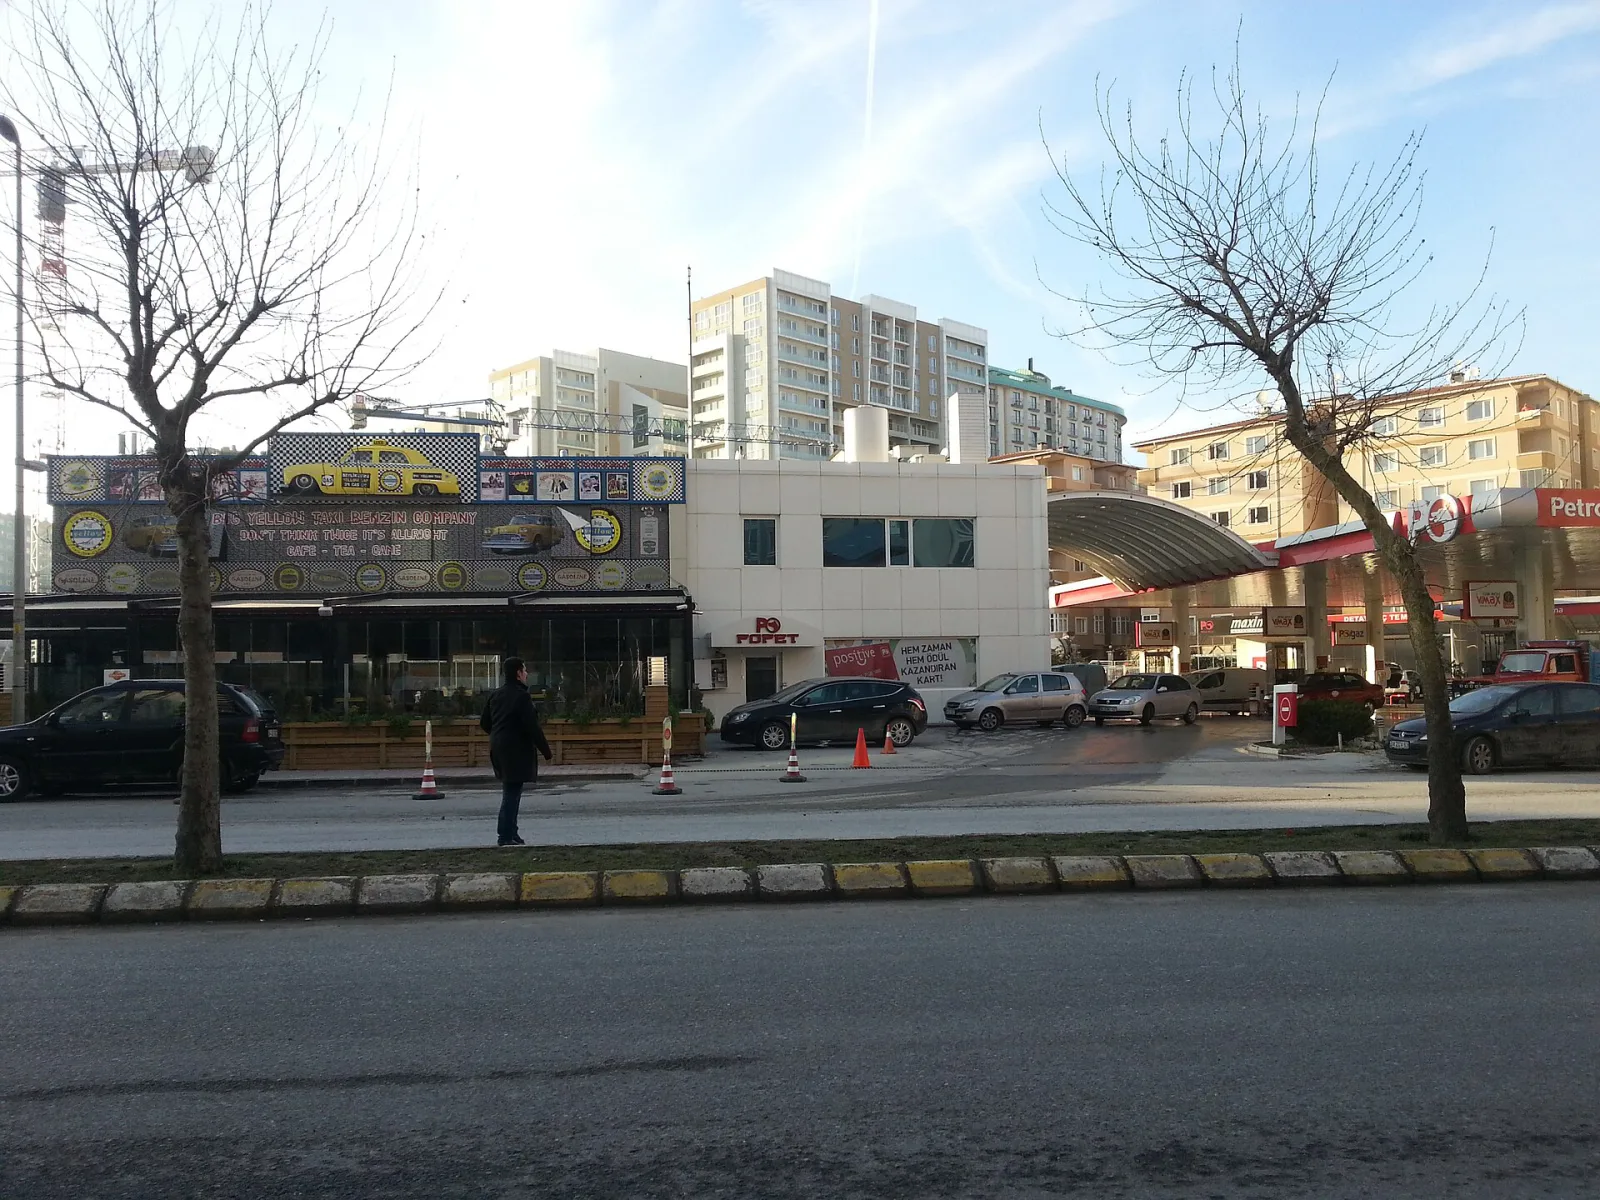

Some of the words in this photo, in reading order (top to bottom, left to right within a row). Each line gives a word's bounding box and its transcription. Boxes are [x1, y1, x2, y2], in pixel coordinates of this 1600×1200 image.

[247, 511, 305, 526] YELLOW
[312, 512, 344, 526] TAXI
[412, 511, 478, 526] COMPANY
[280, 530, 318, 541] THINK
[322, 529, 358, 541] TWICE
[362, 529, 386, 541] IT'S
[286, 545, 317, 557] CAFE
[332, 545, 356, 557] TEA
[1389, 613, 1408, 621] TEM
[756, 617, 781, 634] PO
[901, 644, 920, 655] HEM
[922, 642, 952, 653] ZAMAN
[833, 646, 876, 667] positive
[906, 654, 924, 665] HEM
[926, 652, 950, 664] ÖDÜL
[901, 662, 957, 676] KAZANDIRAN
[917, 674, 943, 685] KART!
